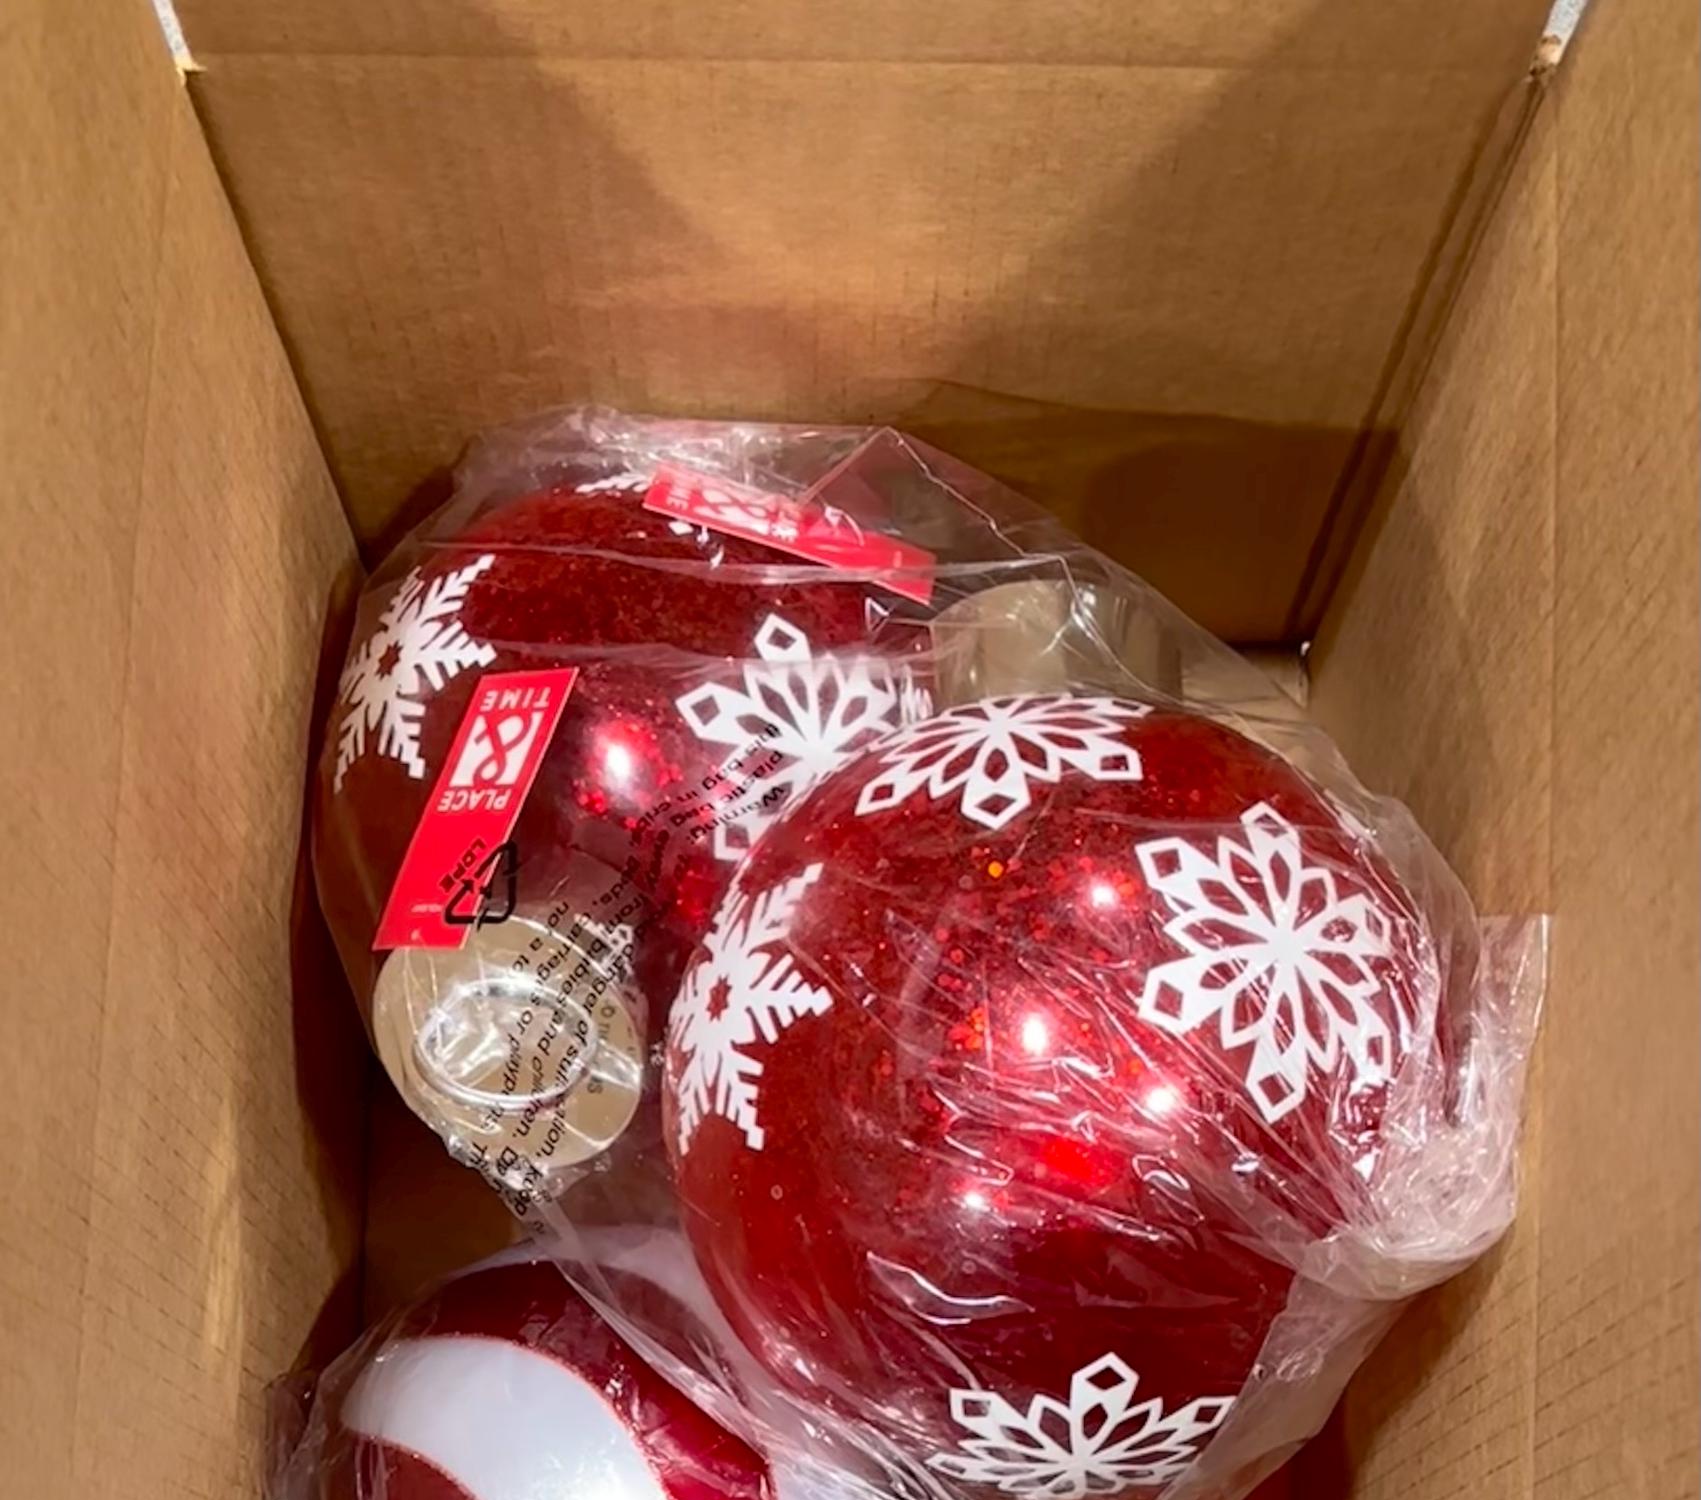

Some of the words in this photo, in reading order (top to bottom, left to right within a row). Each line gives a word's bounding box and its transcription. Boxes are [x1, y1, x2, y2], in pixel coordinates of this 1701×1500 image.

[480, 687, 551, 712] TIME
[458, 711, 540, 786] &
[720, 750, 783, 804] plastic
[437, 788, 512, 812] PLACE
[686, 785, 785, 845] Warning:
[438, 838, 486, 894] LDPE
[604, 893, 651, 934] from
[529, 937, 544, 952] a
[516, 1010, 534, 1036] or
[538, 1008, 565, 1056] and
[575, 1020, 589, 1047] of
